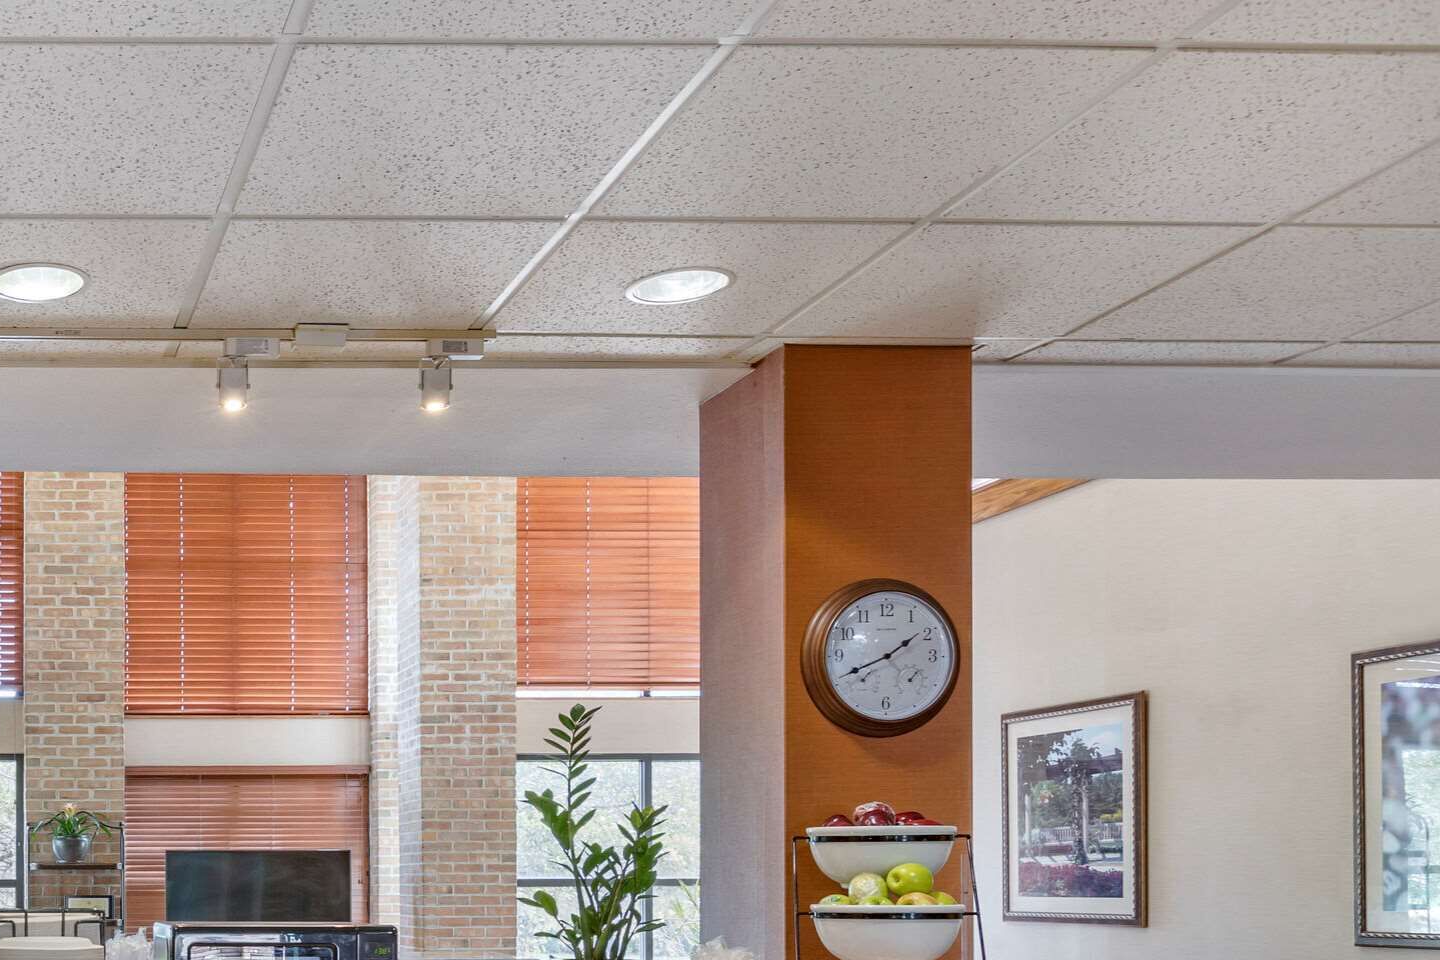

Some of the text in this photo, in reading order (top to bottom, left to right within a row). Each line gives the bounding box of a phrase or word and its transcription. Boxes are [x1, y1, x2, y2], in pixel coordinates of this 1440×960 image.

[858, 609, 870, 623] 11
[879, 603, 894, 617] 12
[907, 609, 914, 623] 1
[840, 627, 854, 641] 10
[923, 627, 932, 641] 2
[834, 649, 844, 662] 9
[928, 649, 937, 663] 3
[881, 696, 891, 710] 6
